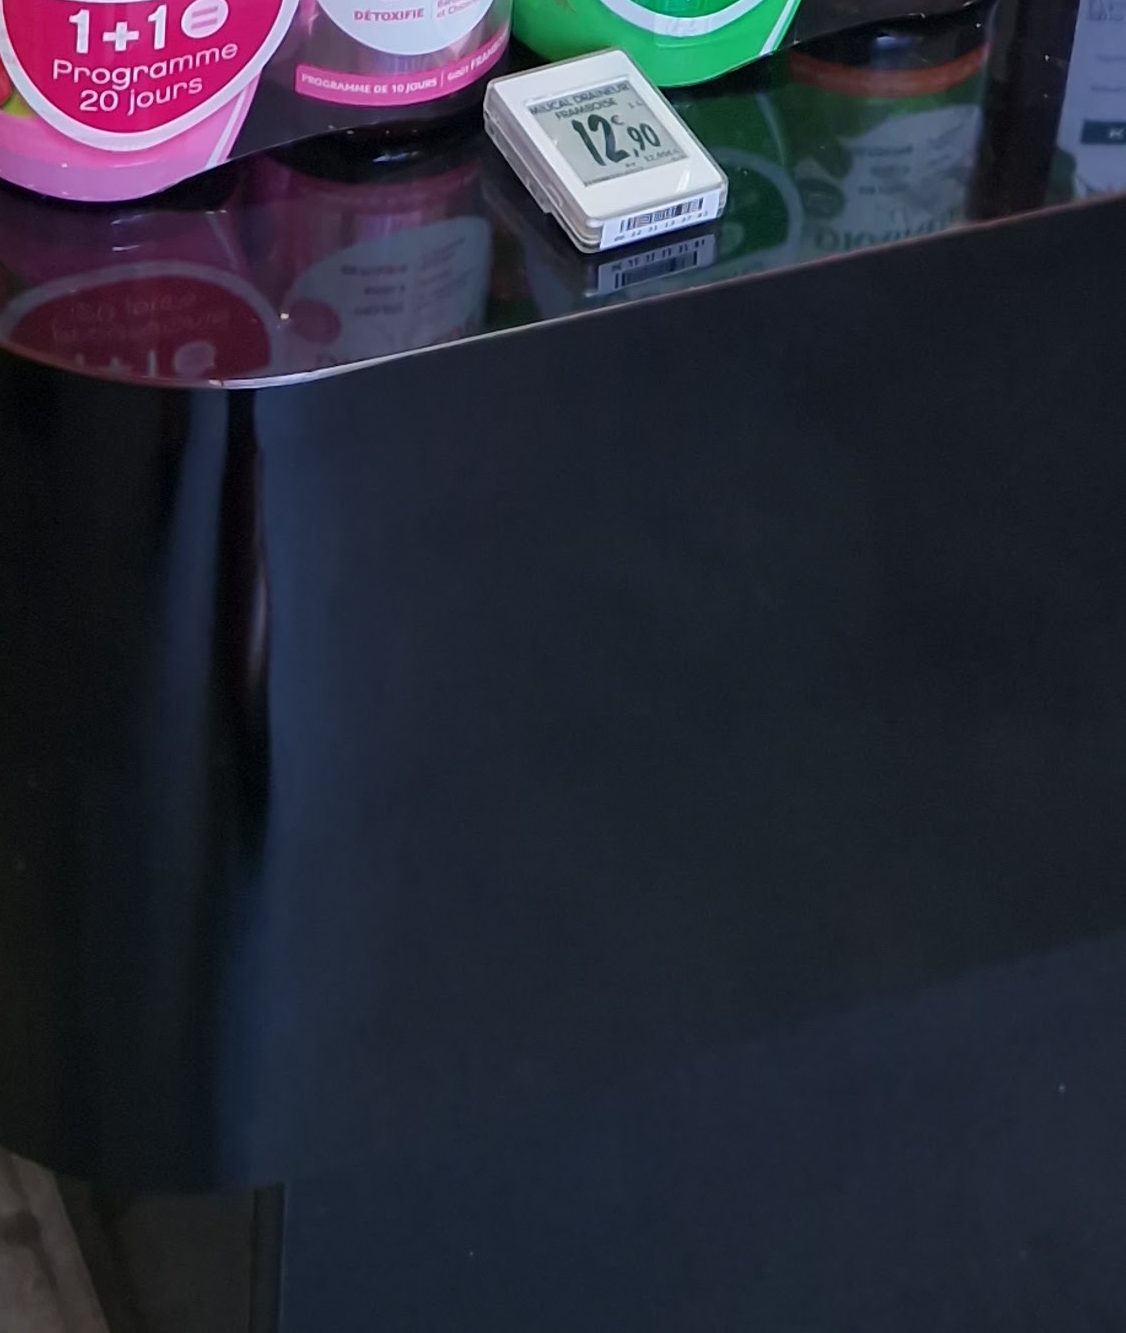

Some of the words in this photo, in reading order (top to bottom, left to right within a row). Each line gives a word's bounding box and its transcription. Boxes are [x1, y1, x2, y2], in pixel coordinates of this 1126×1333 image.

[353, 7, 425, 22] DÉTOXIFIE
[52, 41, 240, 92] Programme
[301, 73, 371, 94] PROGRAMME
[373, 84, 388, 94] DE
[391, 83, 404, 94] 10
[405, 76, 438, 95] JOURS
[78, 88, 121, 113] 20
[126, 76, 204, 117] jours
[528, 98, 573, 116] MILICAL
[554, 97, 619, 120] FRAMBOISE
